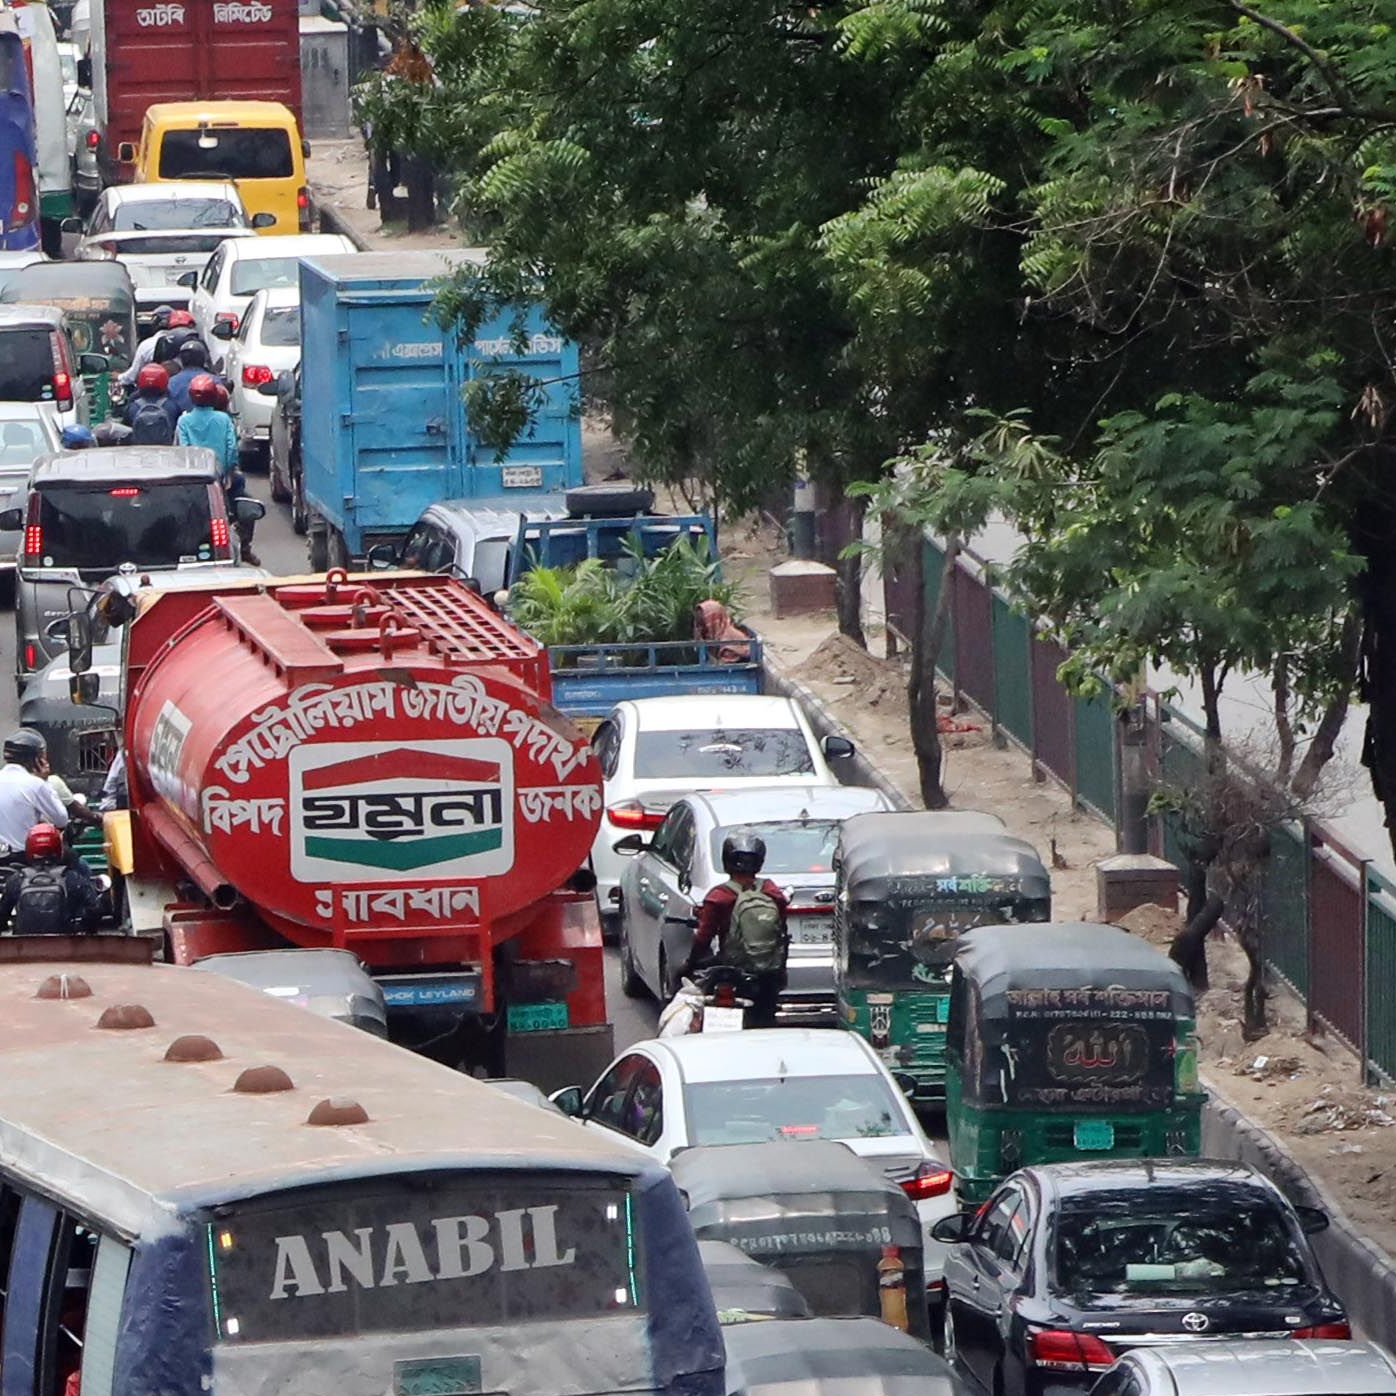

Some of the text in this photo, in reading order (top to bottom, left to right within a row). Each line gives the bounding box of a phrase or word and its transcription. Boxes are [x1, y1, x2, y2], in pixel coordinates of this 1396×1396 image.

[136, 4, 186, 26] অটবি
[213, 674, 591, 784] পেট্রোলিয়াম জাতীয় পদার্থ
[201, 785, 286, 837] বিপদ
[301, 788, 502, 841] যমুনা
[516, 784, 602, 823] জনক
[419, 989, 476, 1000] LEYLAND
[269, 1204, 576, 1300] ANABIL
